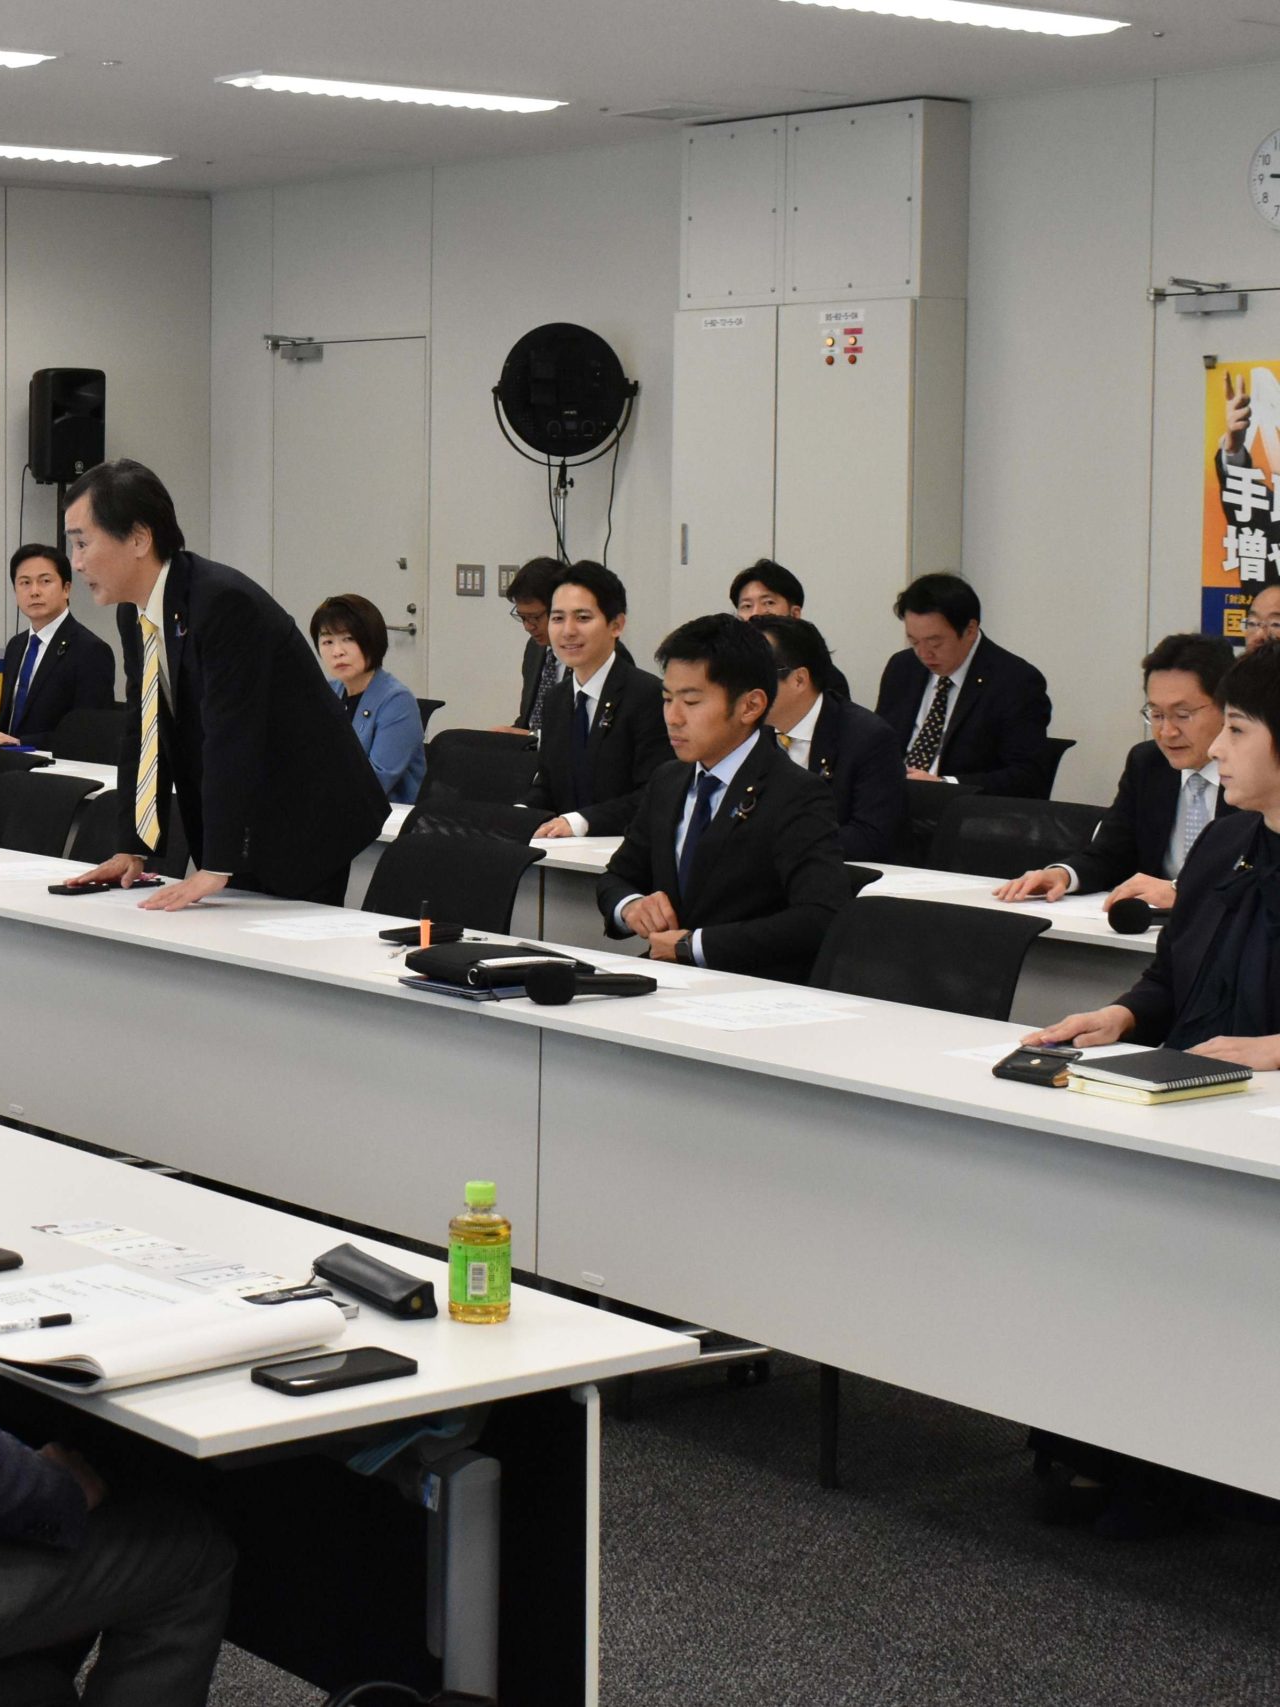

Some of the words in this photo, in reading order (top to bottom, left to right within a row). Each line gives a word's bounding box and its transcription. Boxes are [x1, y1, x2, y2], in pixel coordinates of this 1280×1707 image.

[1262, 153, 1271, 166] 10
[1258, 173, 1265, 185] 9
[1262, 192, 1269, 204] 8
[1274, 204, 1280, 217] 7
